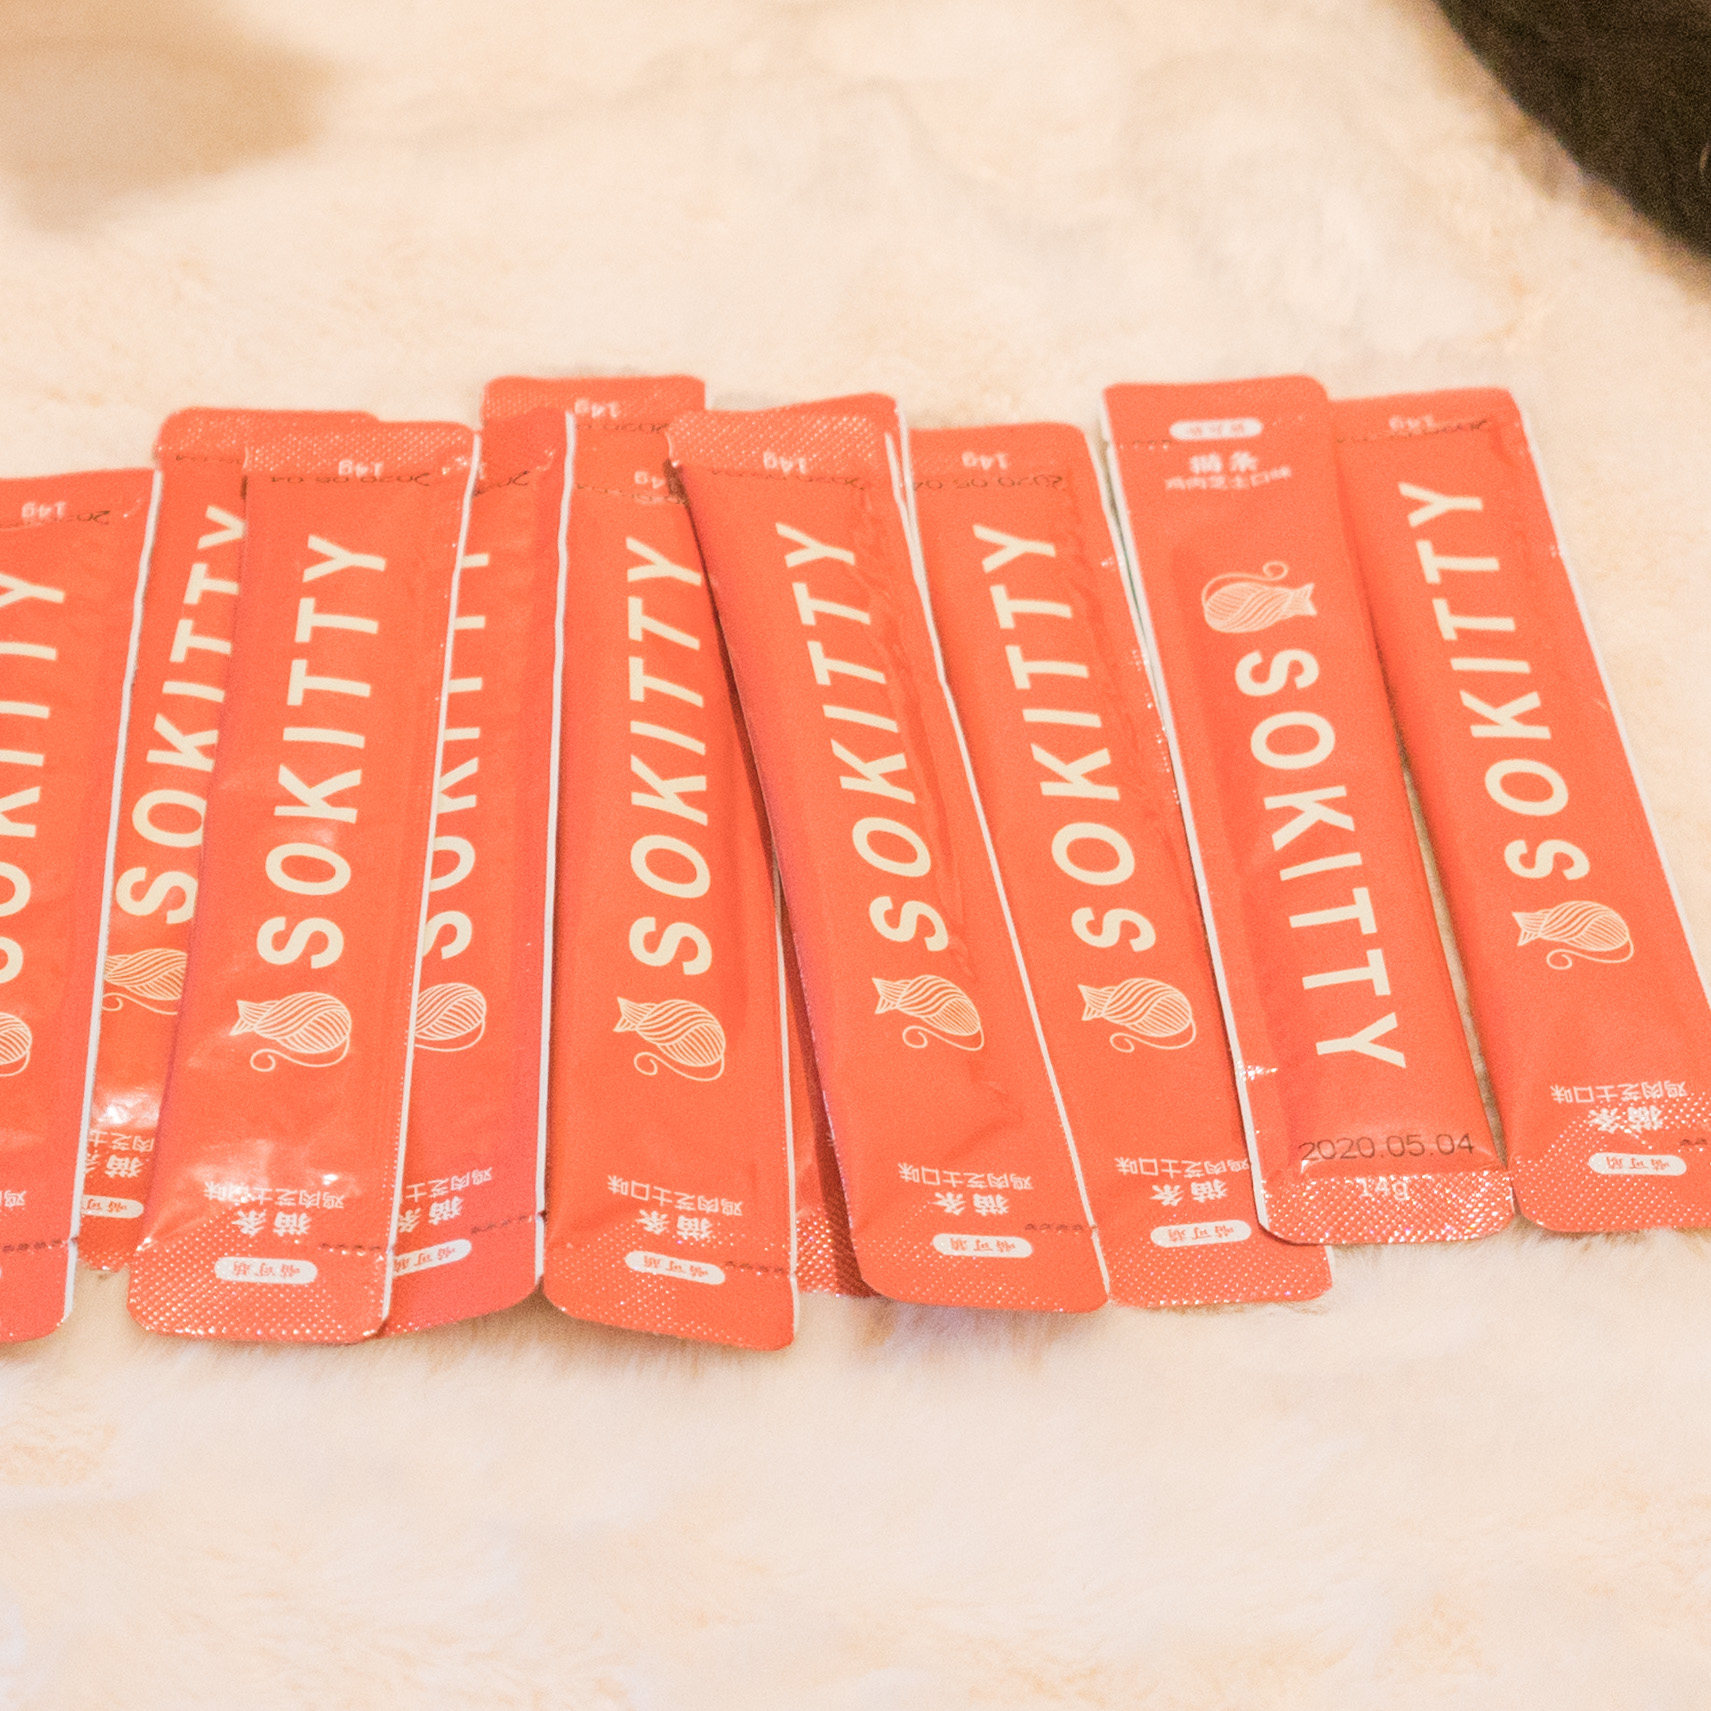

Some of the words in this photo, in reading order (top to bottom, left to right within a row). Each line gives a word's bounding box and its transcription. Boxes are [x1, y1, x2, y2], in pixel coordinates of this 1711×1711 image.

[1397, 482, 1590, 881] SOKITTY
[257, 534, 386, 970] SOKITTY
[626, 537, 713, 975] SOKITTY
[776, 523, 949, 952] SOKITTY
[972, 524, 1156, 952] SOKITTY
[1235, 649, 1406, 1069] SOKITTY
[1588, 1105, 1664, 1135] 猫条
[1299, 1132, 1474, 1164] 2020.05.04
[607, 1174, 744, 1217] 鸡肉芝士口味
[898, 1161, 1034, 1191] 鸡肉芝士口味
[1150, 1178, 1228, 1208] 猫条
[236, 1208, 312, 1237] 猫条
[932, 1191, 1010, 1218] 猫条
[637, 1208, 715, 1243] 猫条
